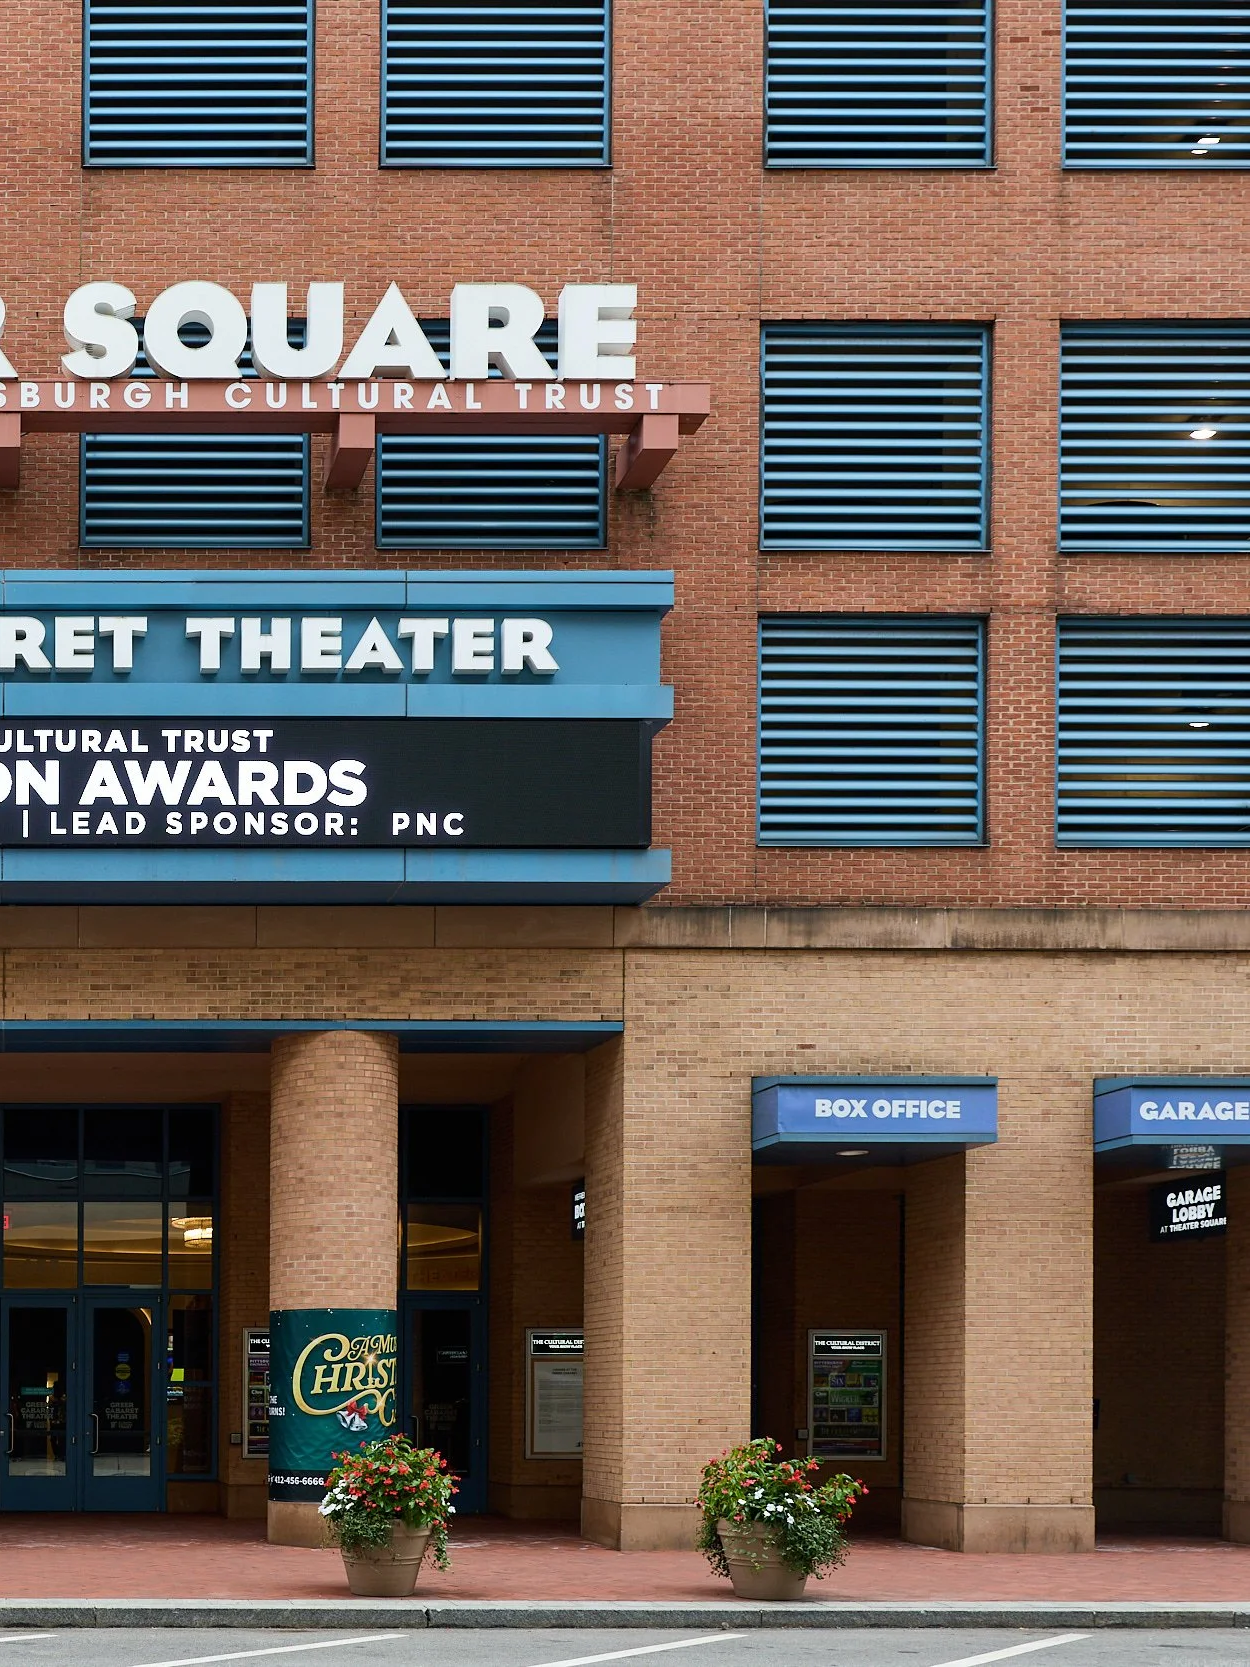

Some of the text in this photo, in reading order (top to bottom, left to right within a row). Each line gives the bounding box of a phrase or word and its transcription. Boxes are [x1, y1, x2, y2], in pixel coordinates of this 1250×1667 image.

[60, 280, 638, 381] SQUARE
[224, 383, 484, 411] CULTURAL
[517, 383, 664, 412] TRUST
[185, 616, 561, 674] THEATER
[161, 729, 274, 753] TRUST
[78, 759, 368, 807] AWARDS
[50, 811, 147, 835] LEAD
[165, 811, 358, 836] SPONSOR:
[392, 812, 464, 836] PNC
[815, 1099, 961, 1119] BOX OFFICE
[1139, 1101, 1250, 1121] GARAGE
[1166, 1185, 1222, 1208] GARAGE
[1172, 1203, 1215, 1223] LOBBY
[1160, 1217, 1227, 1234] AT THEATER SQUARE
[347, 1335, 371, 1361] A
